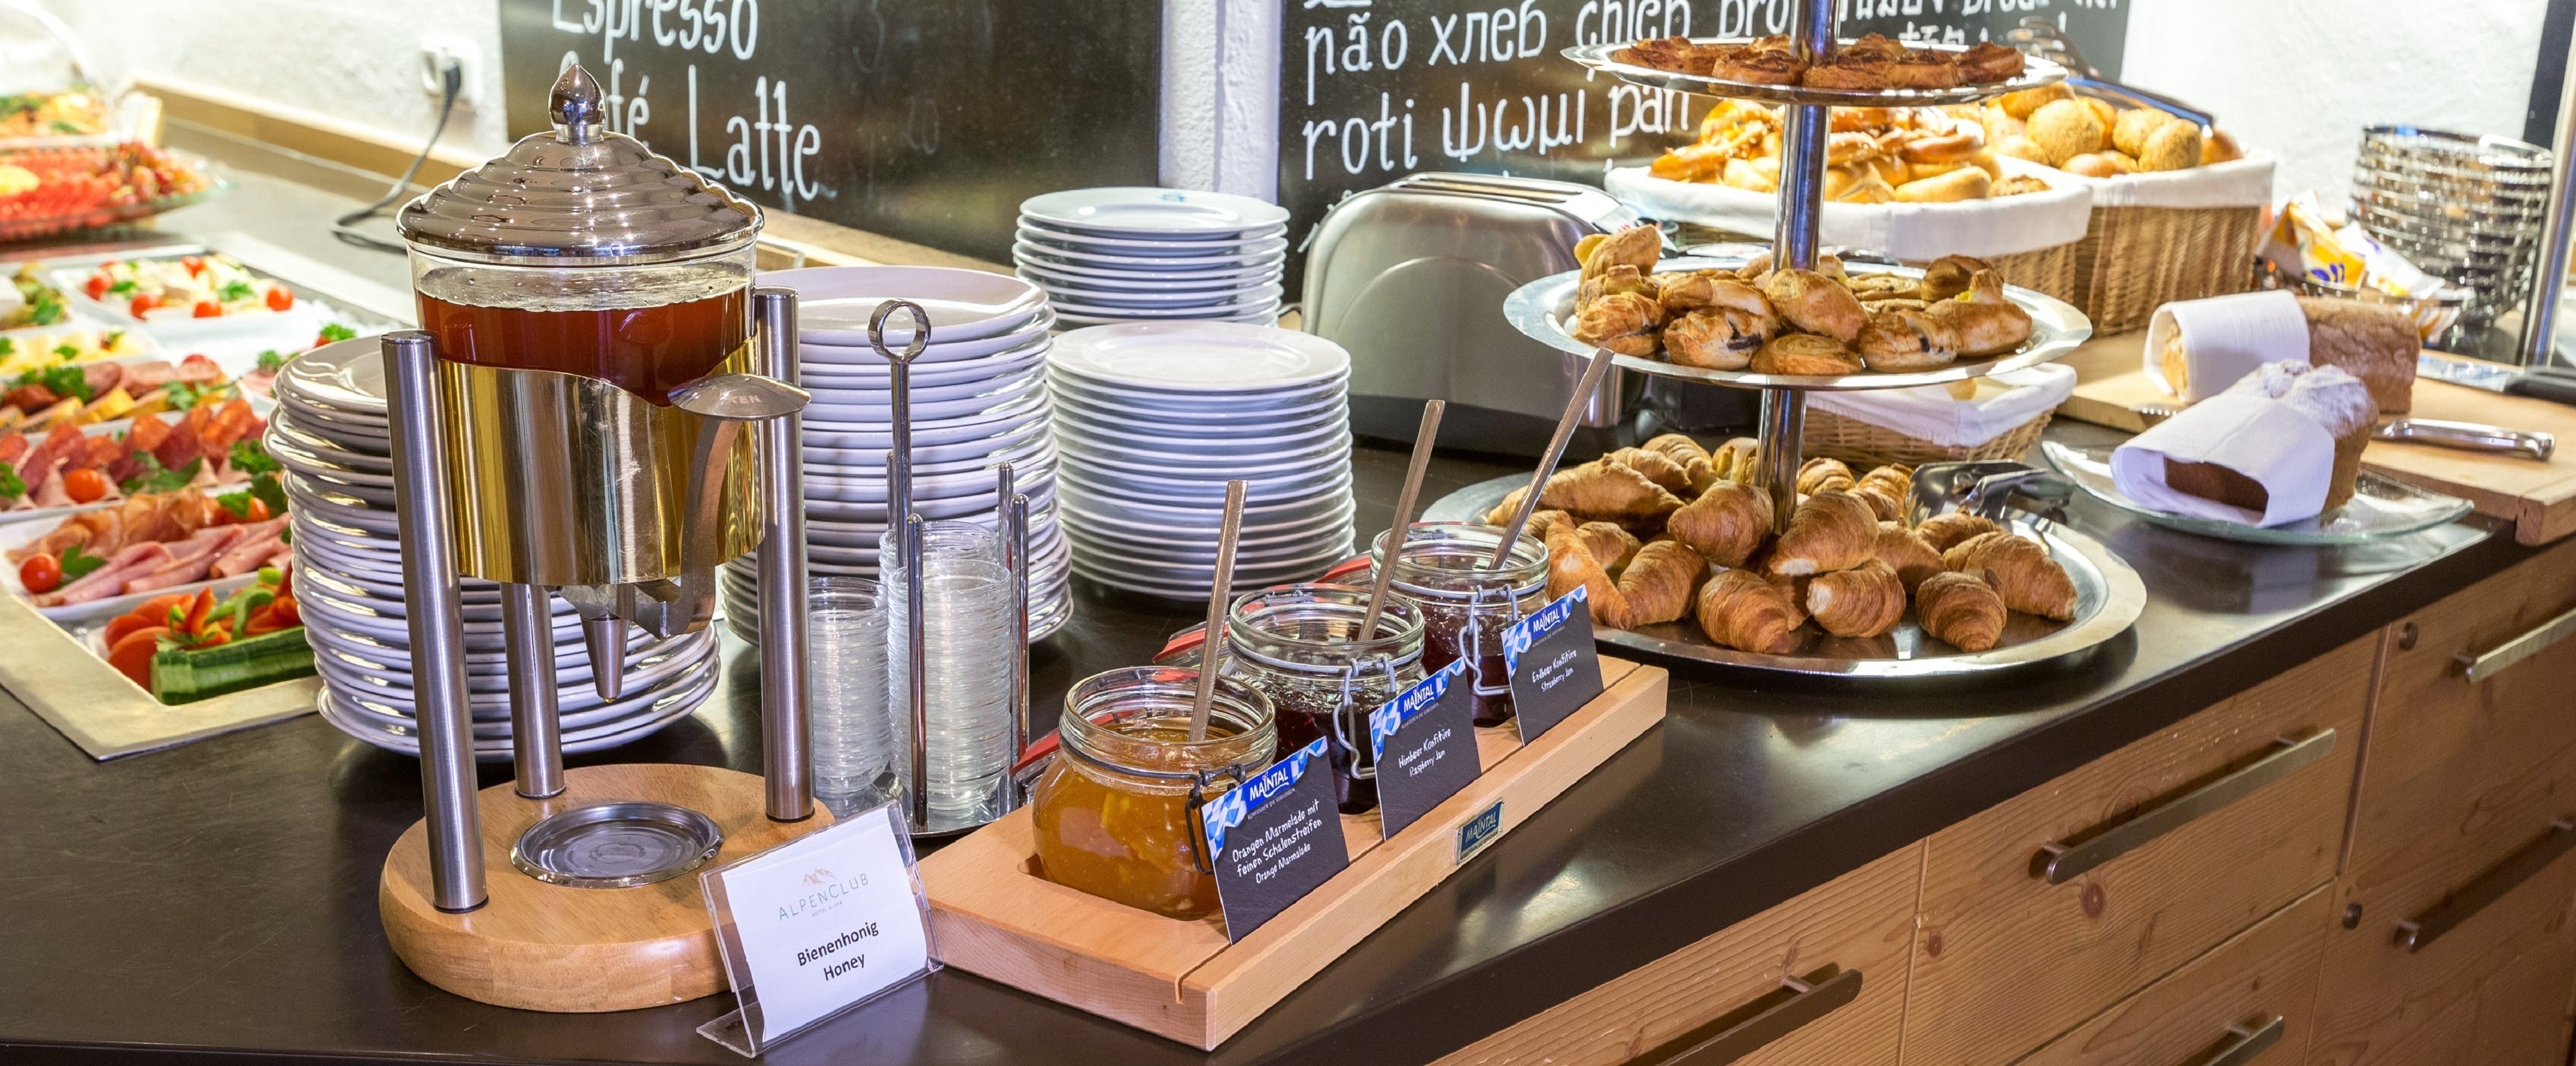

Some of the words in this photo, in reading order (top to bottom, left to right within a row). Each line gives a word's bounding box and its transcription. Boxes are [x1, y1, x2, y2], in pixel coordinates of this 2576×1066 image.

[688, 65, 824, 201] Latte
[1303, 92, 1418, 180] roti
[1533, 608, 1560, 633] MAINTAL
[1532, 666, 1552, 683] Erdbeer
[1565, 667, 1574, 677] Jam
[1404, 684, 1434, 713] MAINTAL
[1398, 747, 1423, 768] Himbeer
[1423, 728, 1452, 752] Konfitüre
[1409, 756, 1434, 777] Raspberry
[1435, 750, 1446, 761] Jam
[1250, 768, 1289, 802] MAINTAL
[1232, 838, 1264, 862] Orangen
[1265, 810, 1305, 843] Marmelade
[1307, 798, 1319, 815] mit
[1465, 811, 1497, 844] MAINTAL
[1237, 857, 1262, 877] feinen
[1262, 819, 1322, 861] Schalenstreifen
[1255, 864, 1277, 884] Orange
[1278, 843, 1311, 870] Marmalade
[811, 908, 828, 917] HOTEL
[797, 921, 879, 966] Bienenhonig
[823, 954, 865, 981] Honey
